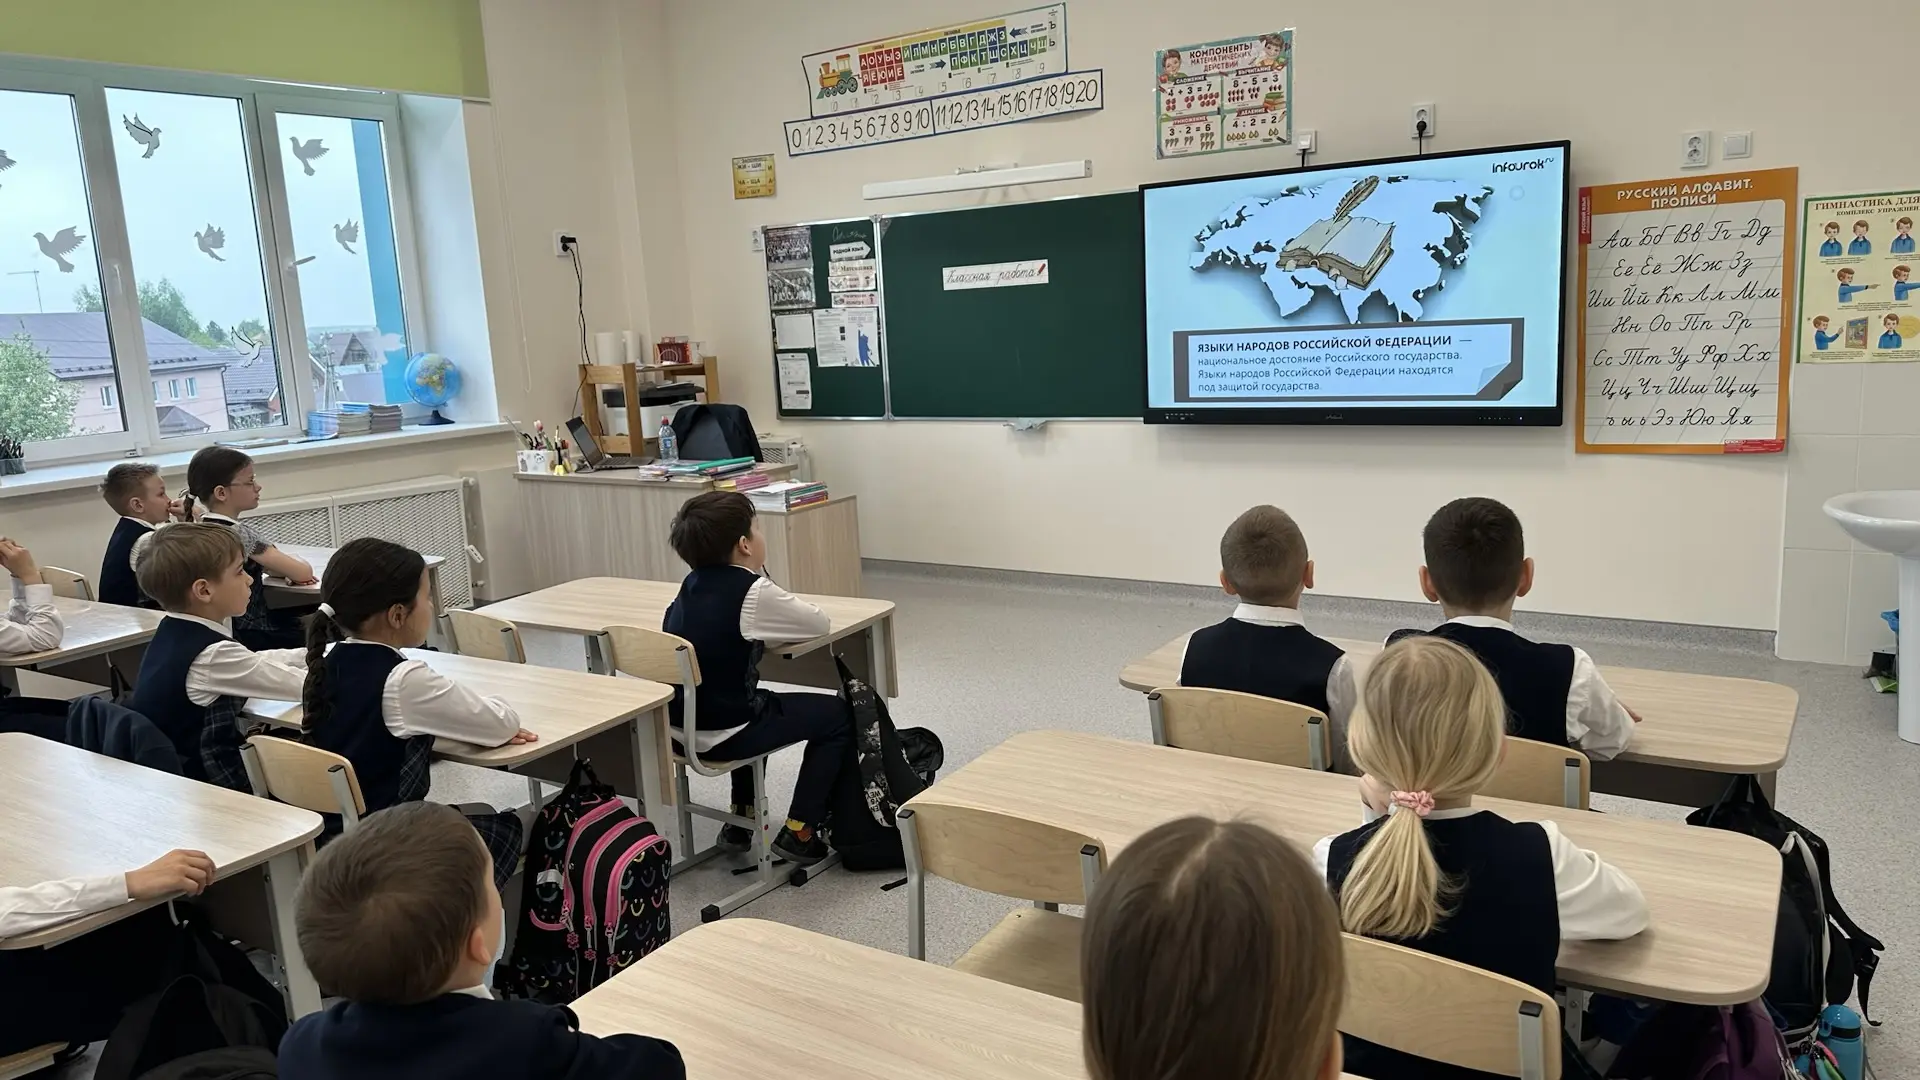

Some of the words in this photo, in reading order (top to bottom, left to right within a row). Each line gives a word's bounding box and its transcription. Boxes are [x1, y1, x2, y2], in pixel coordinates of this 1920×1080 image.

[1189, 43, 1253, 59] КОМПОНЕНТЫ
[1190, 51, 1252, 65] МАТЕМАТИЧЕСКИХ
[935, 105, 946, 126] 11
[948, 102, 963, 125] 12
[965, 99, 980, 121] 13
[981, 97, 995, 119] 14
[997, 93, 1012, 116] 15
[1014, 90, 1027, 113] 16
[1028, 87, 1043, 111] 17
[1044, 84, 1058, 107] 18
[1060, 81, 1075, 107] 19
[1075, 79, 1098, 103] 20
[792, 128, 801, 148] 0
[805, 127, 811, 146] 1
[815, 125, 824, 145] 2
[828, 123, 836, 143] 3
[840, 121, 848, 140] 4
[853, 119, 863, 139] 5
[866, 116, 876, 138] 6
[878, 115, 887, 135] 7
[890, 112, 899, 133] 8
[903, 110, 912, 131] 9
[915, 107, 930, 130] 10
[1492, 158, 1544, 173] infourok
[1617, 183, 1678, 201] РУССКИЙ
[1681, 178, 1753, 195] АЛФАВИТ.
[1651, 193, 1717, 209] ПРОПИСИ
[1815, 198, 1892, 210] ГИМНАСТИКА
[1895, 196, 1920, 205] ДЛЯ
[1836, 208, 1875, 216] КОМПЛЕКС
[1598, 229, 1632, 249] Аа
[1638, 224, 1676, 246] Бб
[1673, 222, 1704, 244] Вв
[1708, 220, 1732, 241] Гг
[1740, 217, 1772, 246] Дд
[947, 269, 991, 284] Классная
[996, 263, 1035, 285] работа
[1612, 258, 1634, 277] Ее
[1640, 254, 1662, 276] Ёё
[1670, 253, 1723, 274] Жж
[1728, 250, 1753, 278] Зз
[1587, 288, 1615, 308] Ии
[1621, 282, 1649, 306] Йй
[1655, 284, 1684, 304] Кк
[1687, 283, 1726, 301] Лл
[1730, 280, 1780, 299] Мм
[1611, 315, 1642, 333] Нн
[1649, 313, 1672, 332] Оо
[1678, 313, 1713, 331] Пп
[1722, 310, 1752, 335] Рр
[1197, 343, 1233, 353] ЯЗЫКИ
[1236, 341, 1290, 352] НАРОДОВ
[1293, 335, 1371, 350] РОССИЙСКОЙ
[1375, 335, 1452, 349] ФЕДЕРАЦИИ
[1198, 356, 1267, 367] национальное
[1269, 354, 1321, 366] достояние
[1325, 352, 1390, 363] Российского
[1394, 351, 1463, 363] государства.
[1592, 348, 1613, 367] Сс
[1618, 347, 1662, 366] Тт
[1667, 346, 1690, 372] Уу
[1695, 344, 1728, 371] Фф
[1733, 343, 1772, 362] Хх
[1198, 369, 1227, 379] Языки
[1229, 369, 1270, 380] народов
[1273, 367, 1332, 378] Российской
[1335, 366, 1395, 378] Федерации
[1398, 365, 1454, 376] находятся
[1198, 383, 1216, 394] под
[1218, 381, 1259, 393] защитой
[1601, 378, 1632, 400] Цц
[1638, 377, 1663, 395] Чч
[1667, 375, 1709, 395] Шш
[1713, 375, 1760, 399] Щщ
[1606, 416, 1615, 426] ъ
[1621, 416, 1635, 426] ы
[1639, 416, 1647, 426] ь
[1651, 408, 1674, 425] Ээ
[1679, 407, 1715, 426] Юю
[1720, 406, 1753, 425] Яя
